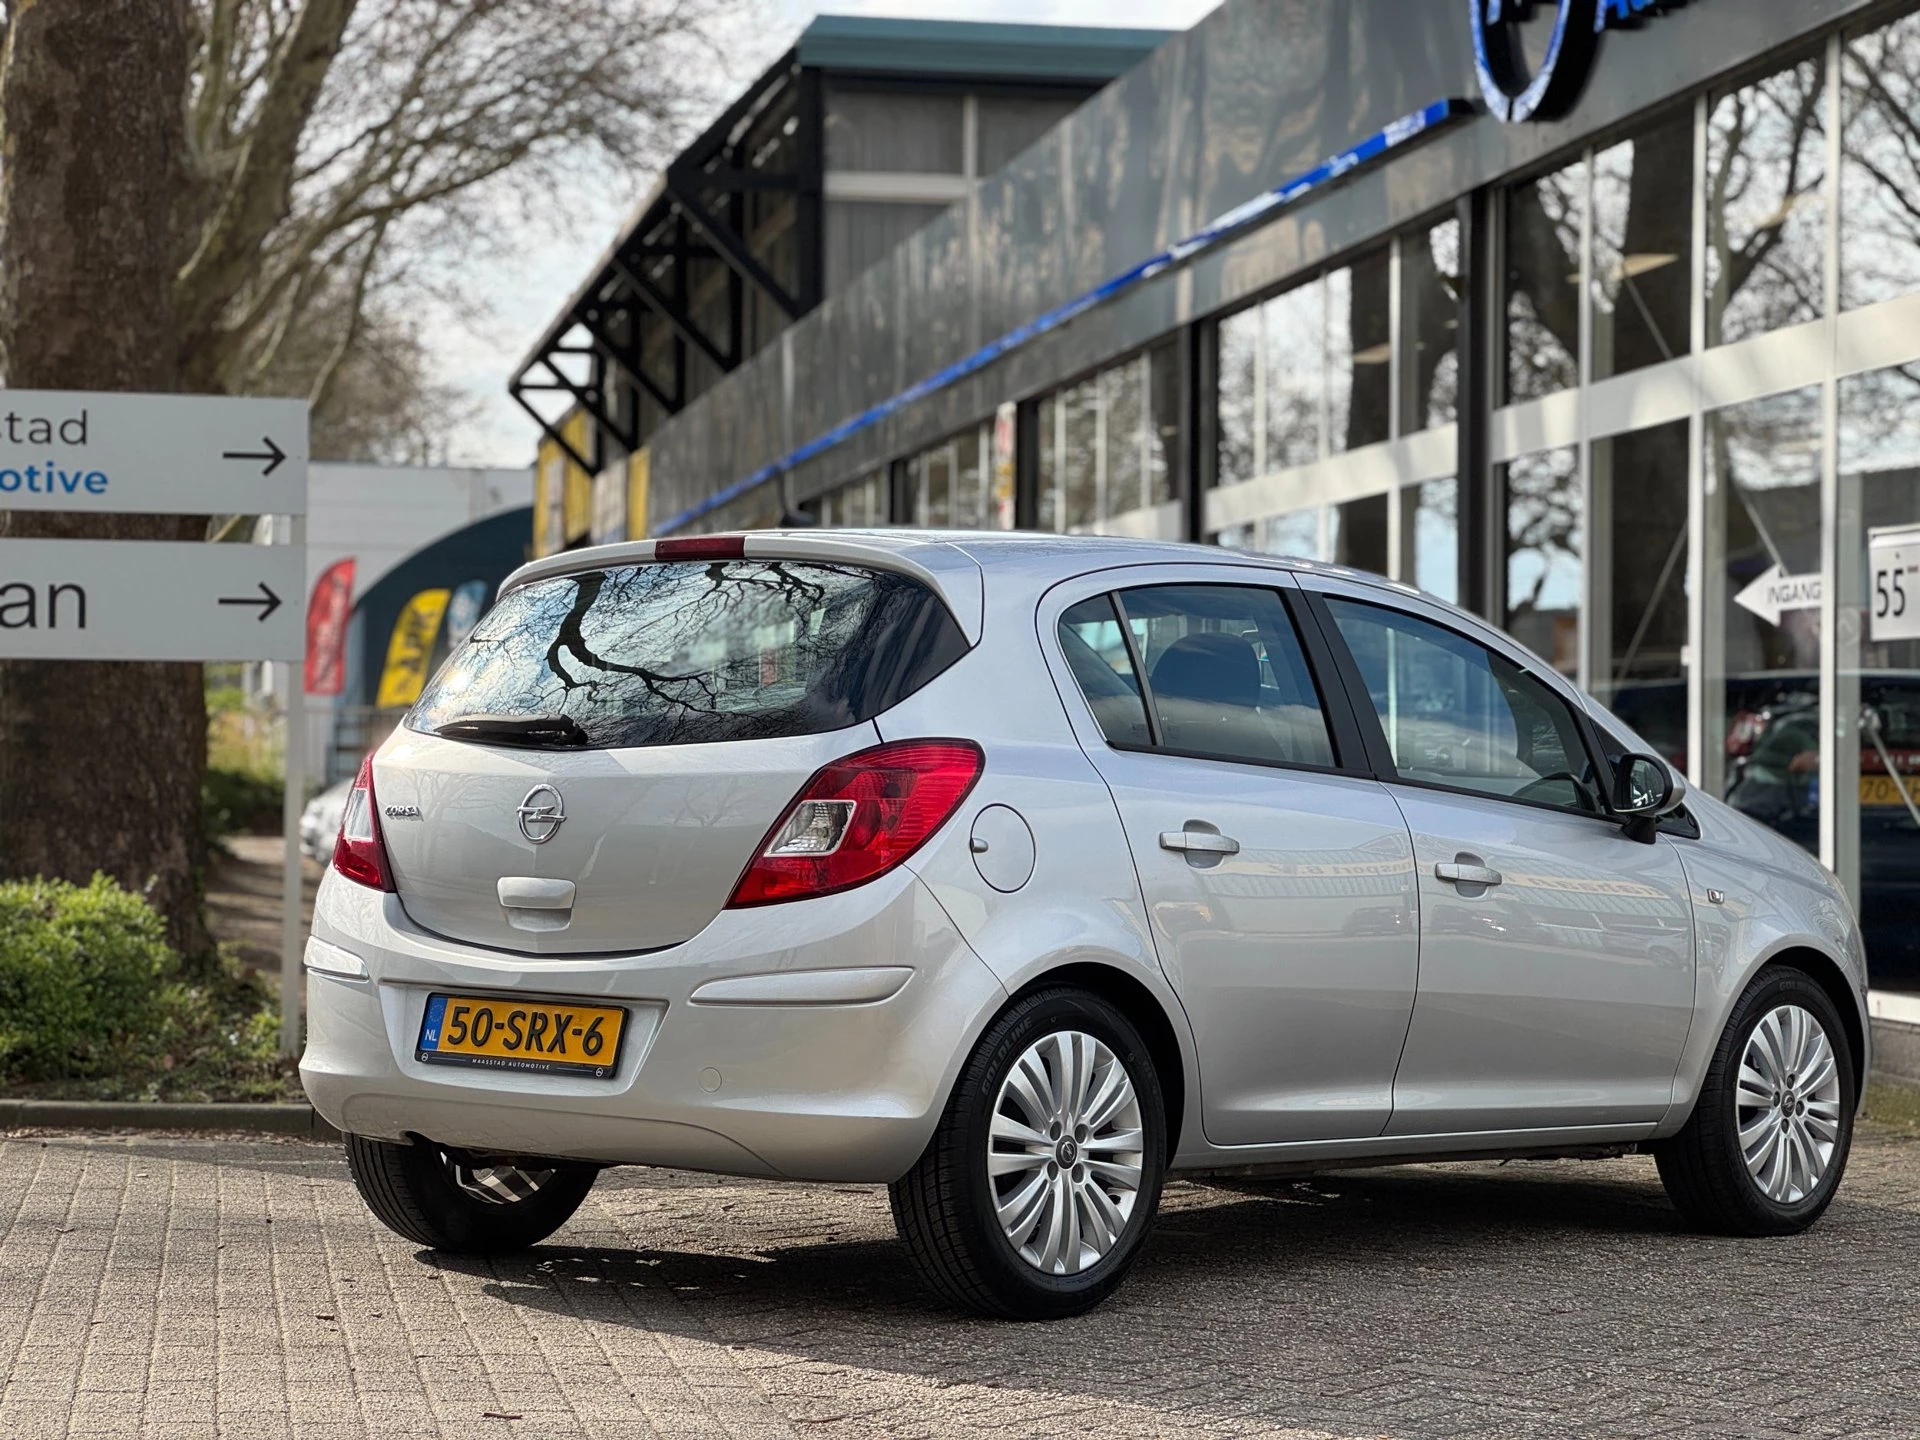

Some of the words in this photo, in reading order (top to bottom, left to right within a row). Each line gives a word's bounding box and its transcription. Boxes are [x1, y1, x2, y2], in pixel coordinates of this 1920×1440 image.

[0, 409, 87, 445] tad
[0, 460, 109, 495] otive
[0, 583, 87, 629] an
[1876, 569, 1906, 618] 55
[384, 805, 421, 817] CORSA
[424, 1028, 438, 1042] NL
[447, 1006, 604, 1057] 50-SRX-6
[472, 1058, 506, 1066] MAASSTAD
[508, 1061, 551, 1070] AUTOMOTIVE
